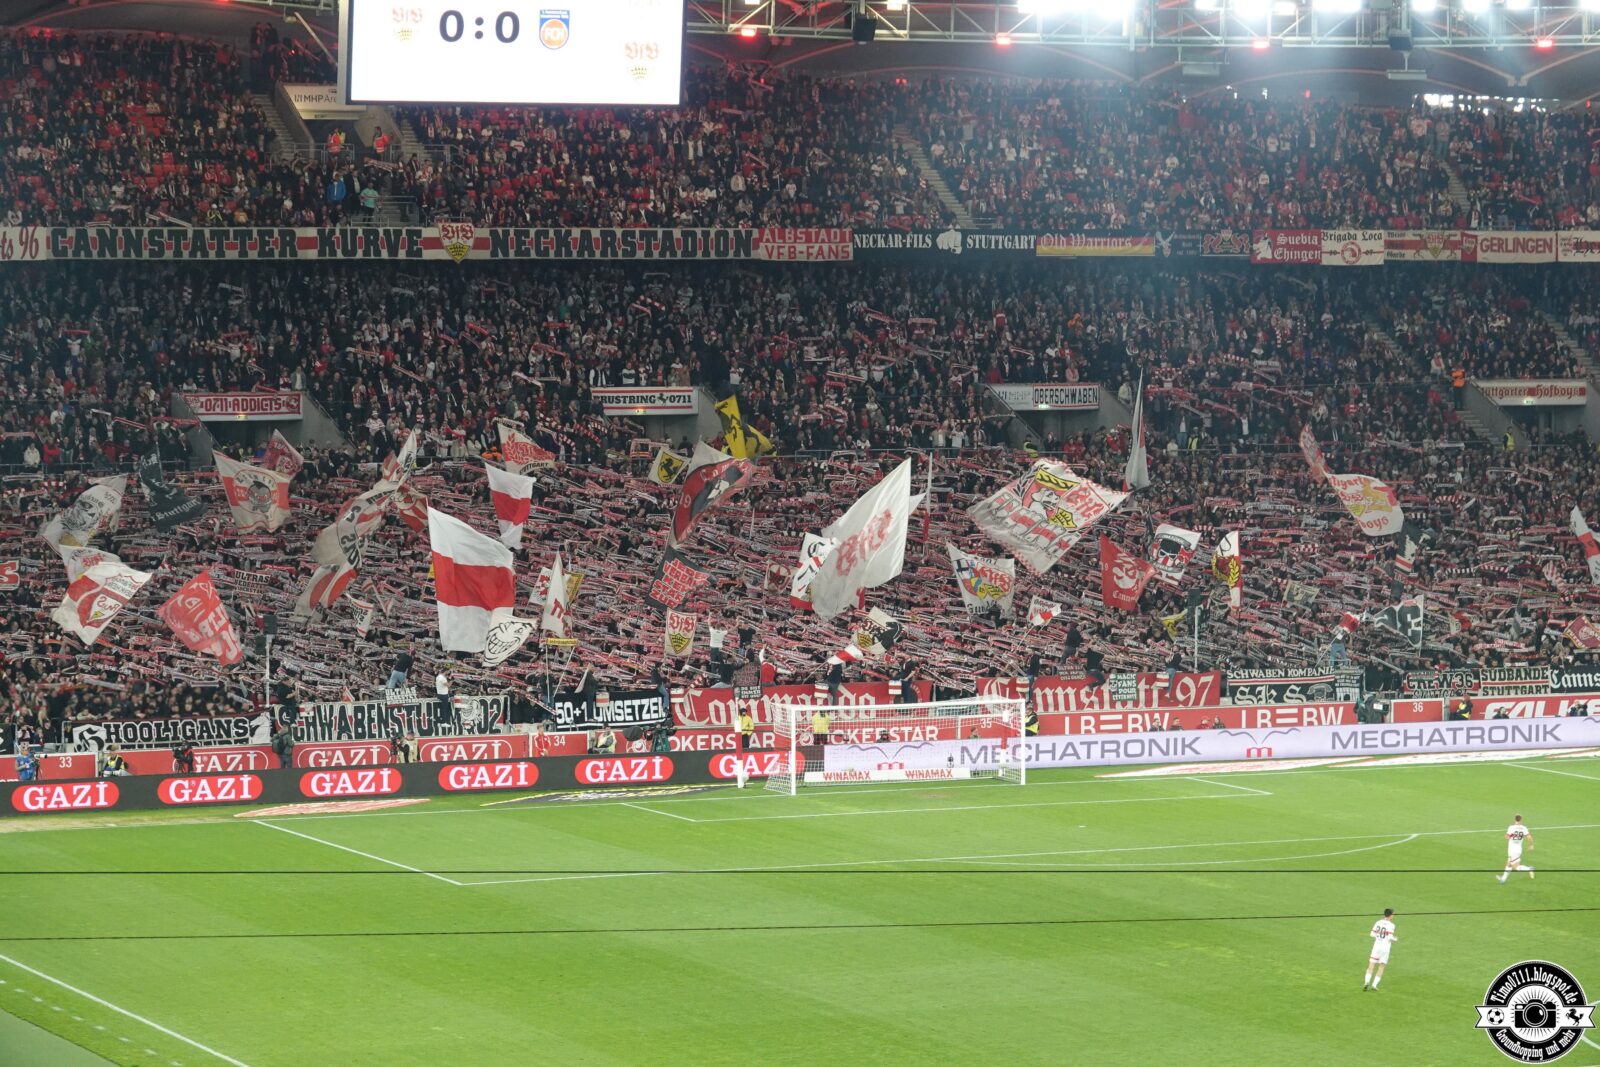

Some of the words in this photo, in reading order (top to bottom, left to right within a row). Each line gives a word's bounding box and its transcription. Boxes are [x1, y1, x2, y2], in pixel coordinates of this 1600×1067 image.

[20, 226, 39, 260] 96
[762, 228, 852, 243] ALBSTADT
[853, 233, 932, 248] NECKAR-FILS
[966, 234, 1036, 249] STUTTGART
[1041, 232, 1066, 250] Old
[1071, 232, 1132, 250] Warriors
[1276, 232, 1319, 246] Suebia
[1321, 230, 1357, 243] Brigada
[1361, 230, 1383, 242] Loca
[51, 228, 297, 259] CANNSTATTER
[317, 228, 423, 258] KURVE
[490, 228, 753, 259] NECKARSTADION
[1479, 237, 1553, 254] GERLINGEN
[765, 245, 850, 261] VFB-FANS
[667, 394, 692, 404] 0711
[1034, 387, 1098, 404] OBERSCHWABEN
[204, 398, 229, 412] 0711
[232, 398, 283, 412] ADDICTS
[235, 570, 270, 583] ULTRAS
[1227, 669, 1285, 680] SCHWABEN
[1453, 671, 1474, 689] 36
[1175, 674, 1215, 708] 97
[1482, 684, 1550, 697] STUTTGART
[1412, 701, 1424, 713] 36
[478, 699, 502, 734] 02
[103, 717, 249, 744] HOOLIGANS
[1331, 723, 1562, 751] MECHATRONIK
[553, 735, 566, 747] 34
[960, 736, 1201, 765] MECHATRONIK
[59, 756, 73, 768] 33
[822, 770, 872, 781] WINAMAX
[904, 768, 954, 780] WINAMAX
[1512, 831, 1524, 841] 29
